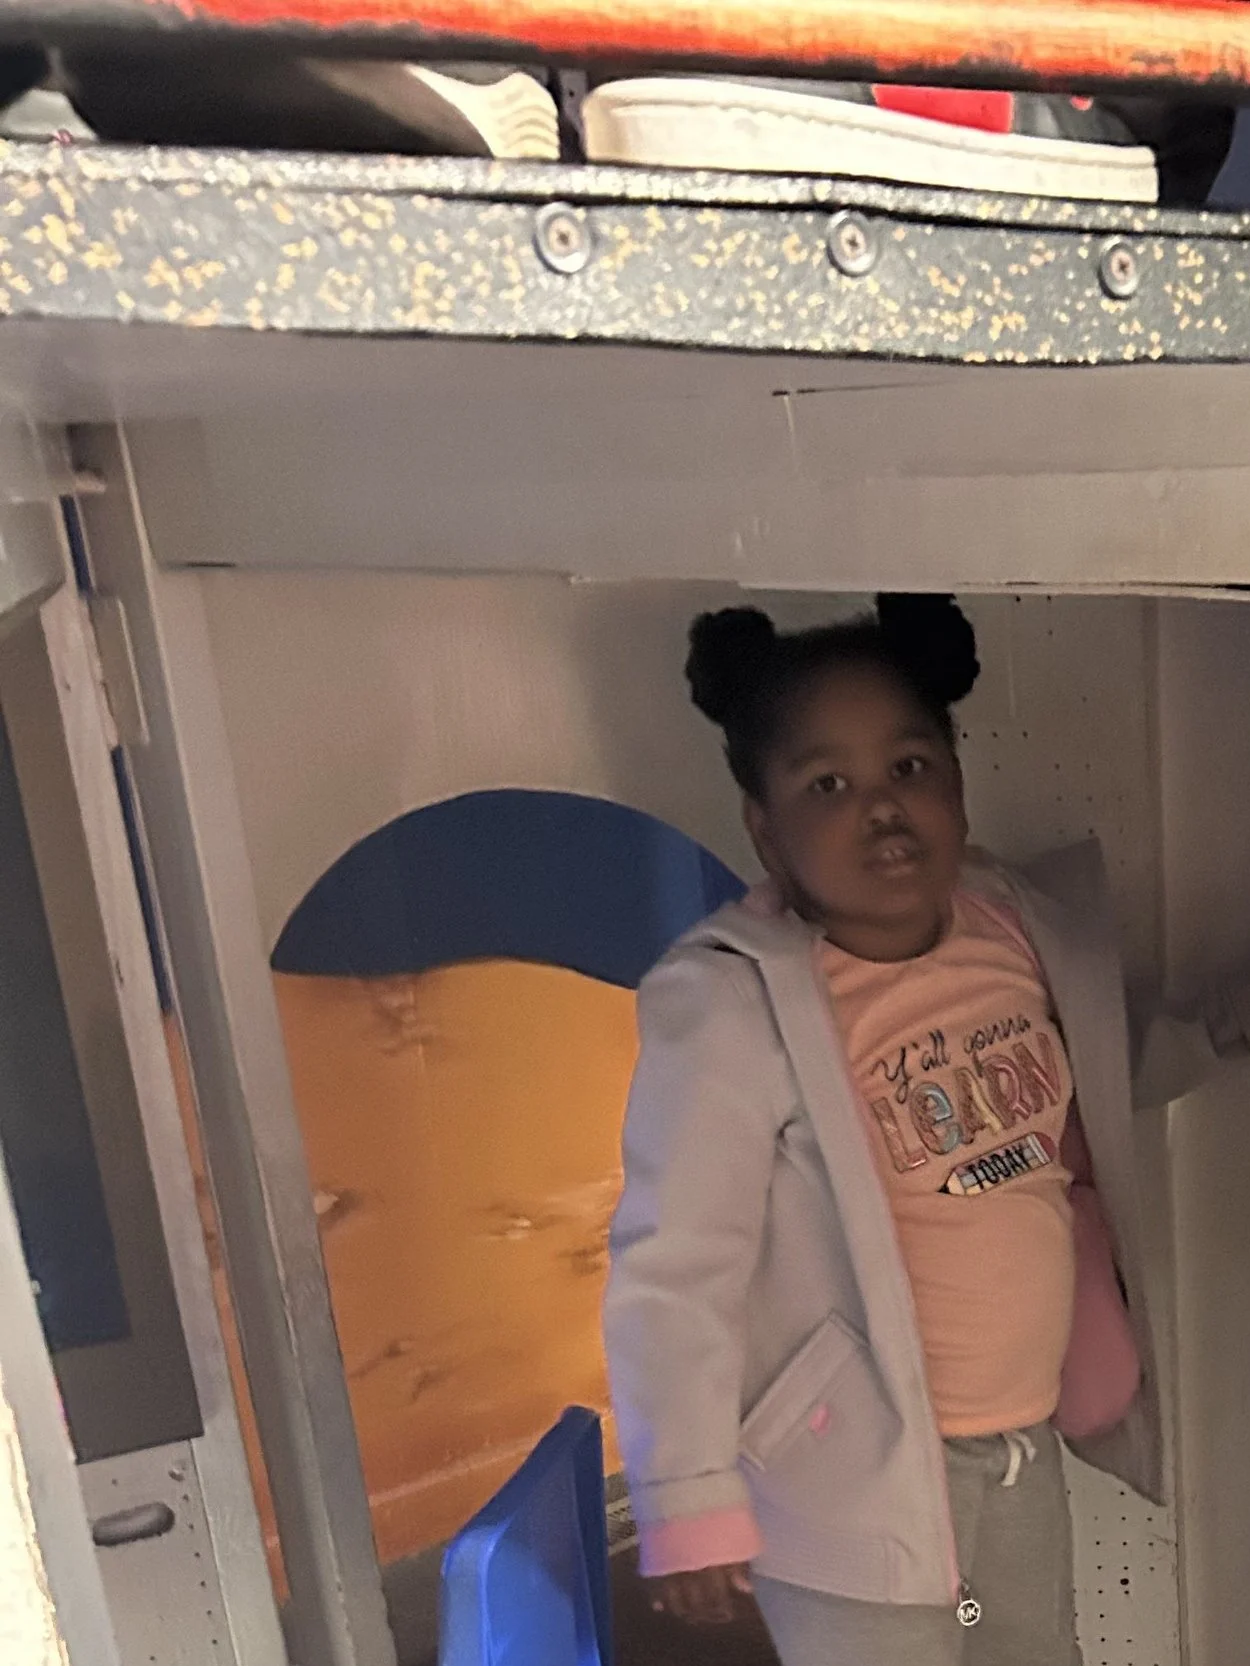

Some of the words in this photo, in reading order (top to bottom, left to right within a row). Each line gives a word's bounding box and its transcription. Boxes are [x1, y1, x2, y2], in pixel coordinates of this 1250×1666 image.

[870, 1028, 950, 1104] Y'all
[964, 1014, 1031, 1077] gonna
[967, 1143, 1034, 1190] TODAY
